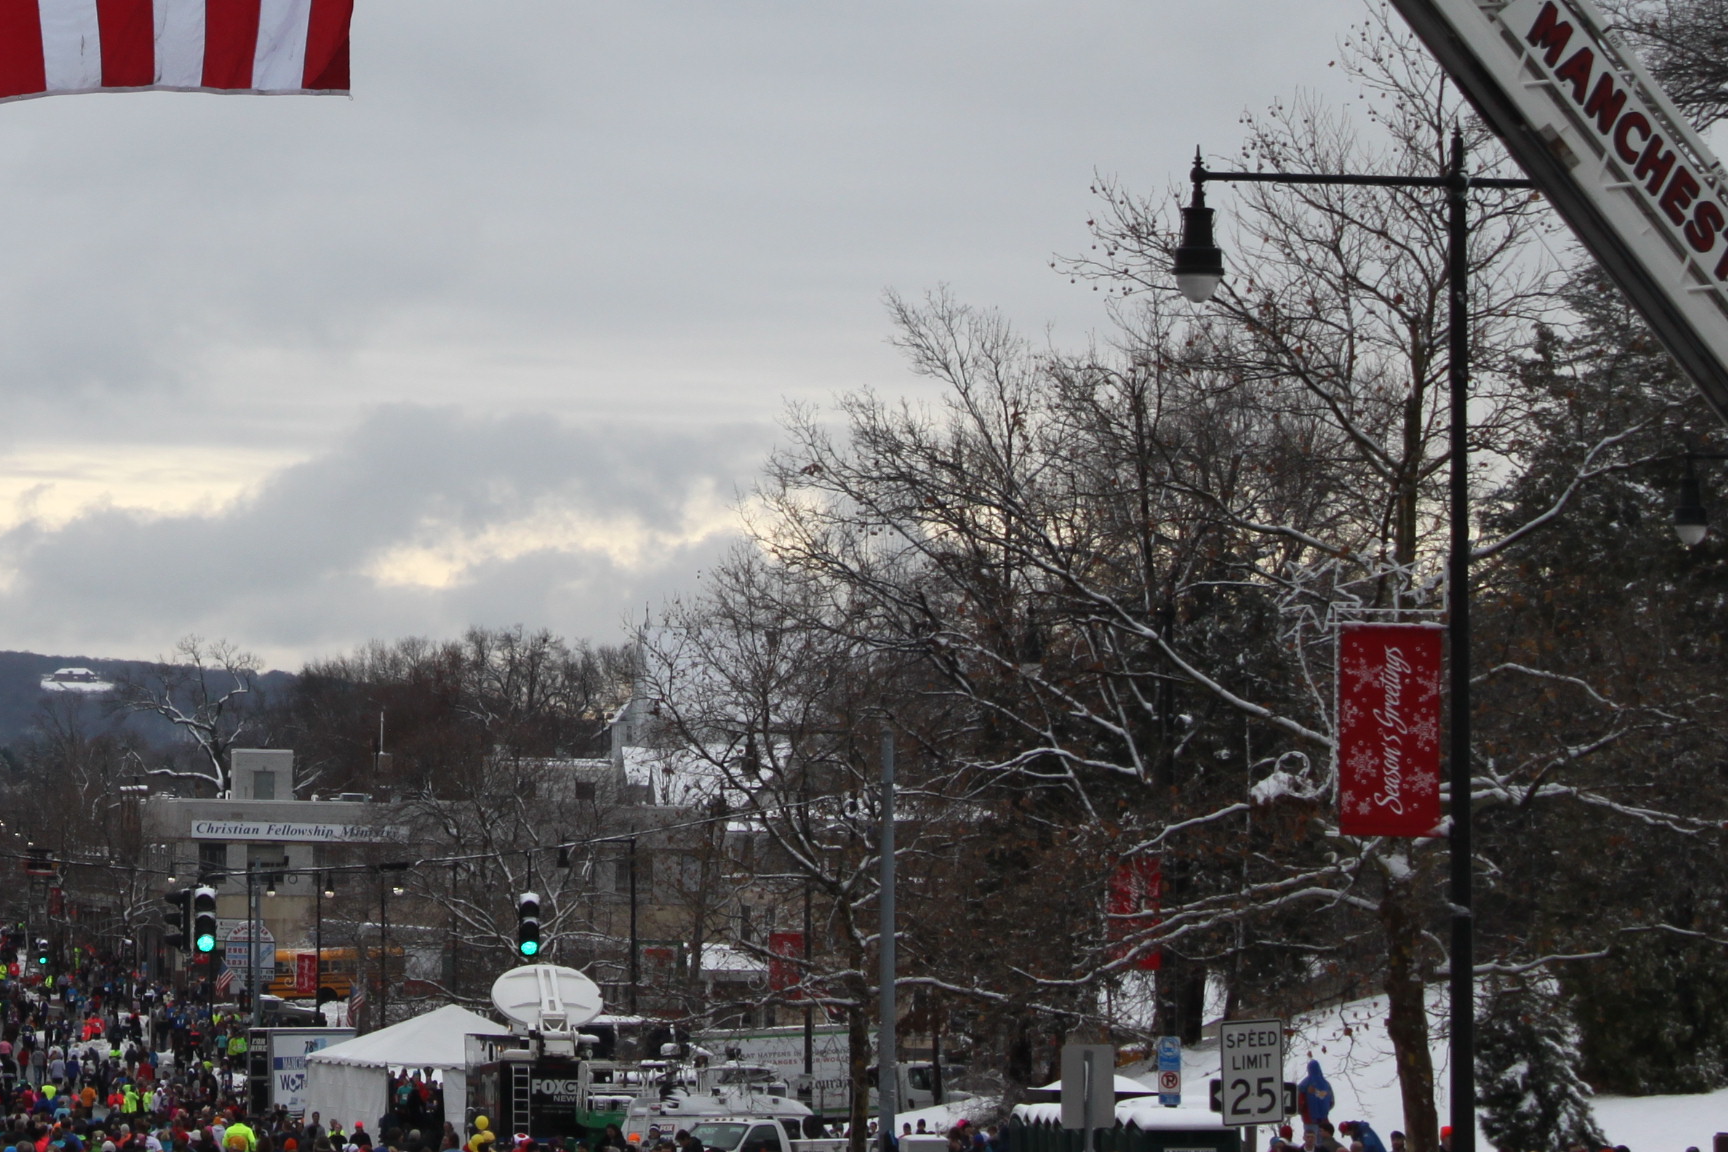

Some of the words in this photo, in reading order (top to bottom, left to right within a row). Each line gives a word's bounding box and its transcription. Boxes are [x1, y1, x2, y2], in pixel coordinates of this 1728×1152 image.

[1372, 644, 1412, 735] Greetings
[1373, 732, 1404, 815] Season's
[196, 823, 260, 835] Christian
[266, 823, 334, 838] Fellowship
[341, 826, 399, 839] Minitry
[1226, 1031, 1277, 1049] SPEED
[283, 1056, 306, 1069] MANCH
[1232, 1053, 1271, 1070] LIMIT
[531, 1078, 578, 1096] FOXC
[1230, 1077, 1276, 1115] 25
[553, 1094, 577, 1103] NEW
